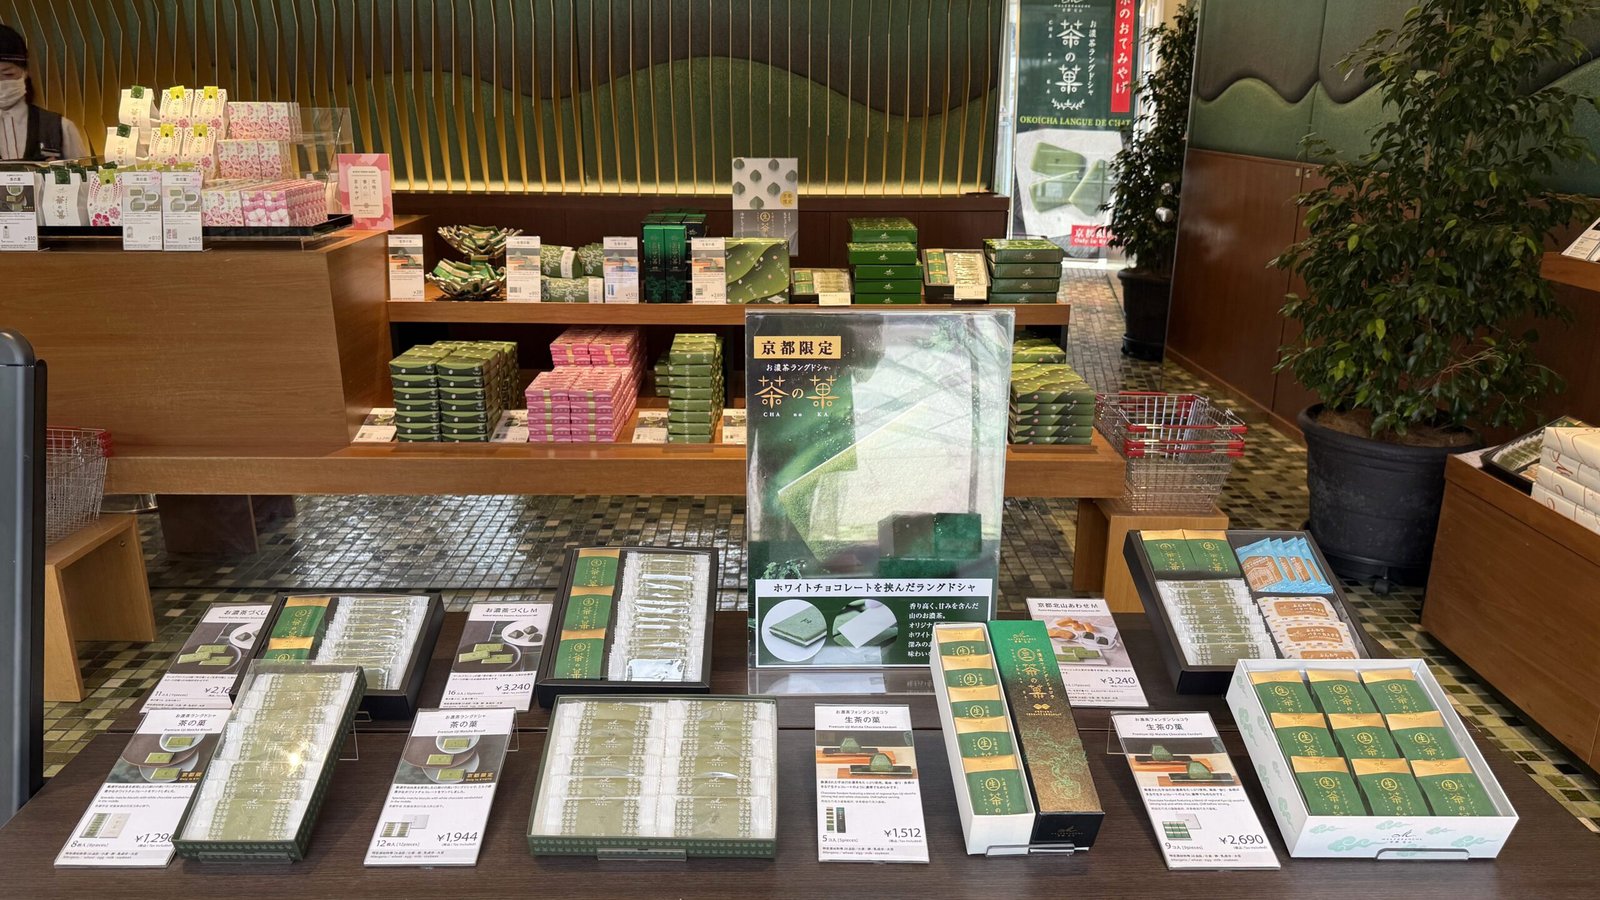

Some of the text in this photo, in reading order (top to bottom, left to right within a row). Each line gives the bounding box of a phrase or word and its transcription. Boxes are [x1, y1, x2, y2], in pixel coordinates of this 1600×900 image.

[1020, 116, 1058, 125] OKOICHA
[1060, 117, 1093, 126] LANGUE
[1095, 118, 1107, 127] DE
[761, 340, 833, 355] 京都限定
[766, 363, 829, 372] お濃茶ラングドシャ
[773, 583, 976, 593] ホワイトチョコレートを挟んだラングドシャ
[909, 602, 979, 610] 香り高く、甘みを含んだ
[908, 631, 935, 639] ホワイト
[1100, 677, 1136, 685] ¥3,240
[205, 686, 231, 695] ¥2,16
[496, 683, 531, 691] ¥3,240
[177, 719, 207, 727] 茶の菓
[450, 720, 478, 728] 茶の菓
[845, 716, 880, 724] 生茶の菓
[1146, 723, 1184, 731] 生茶の菓
[884, 827, 921, 838] ¥1,512
[437, 832, 478, 843] ¥1,944
[1219, 834, 1264, 845] ¥2,690
